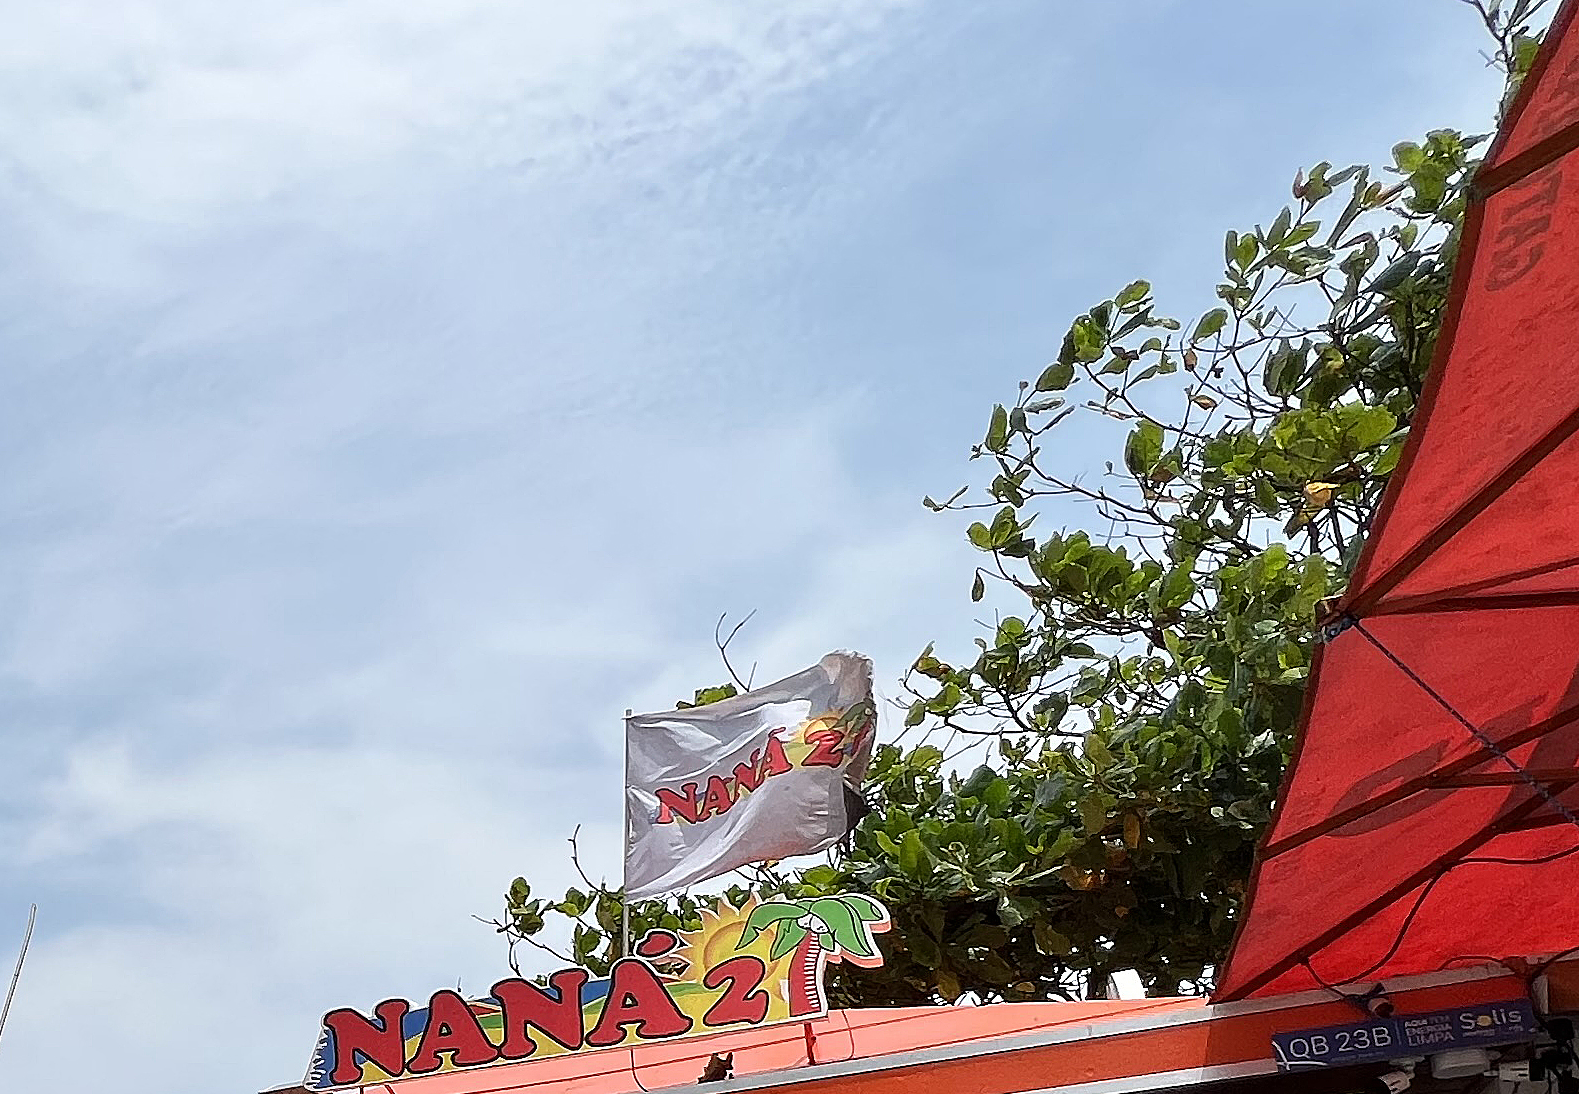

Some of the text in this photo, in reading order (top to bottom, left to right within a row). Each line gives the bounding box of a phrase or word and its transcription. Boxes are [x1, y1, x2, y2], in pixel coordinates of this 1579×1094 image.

[655, 728, 844, 826] NANÁ 2
[324, 930, 770, 1087] NANÁ 2
[1289, 1036, 1330, 1059] QB
[1334, 1026, 1392, 1052] 23B
